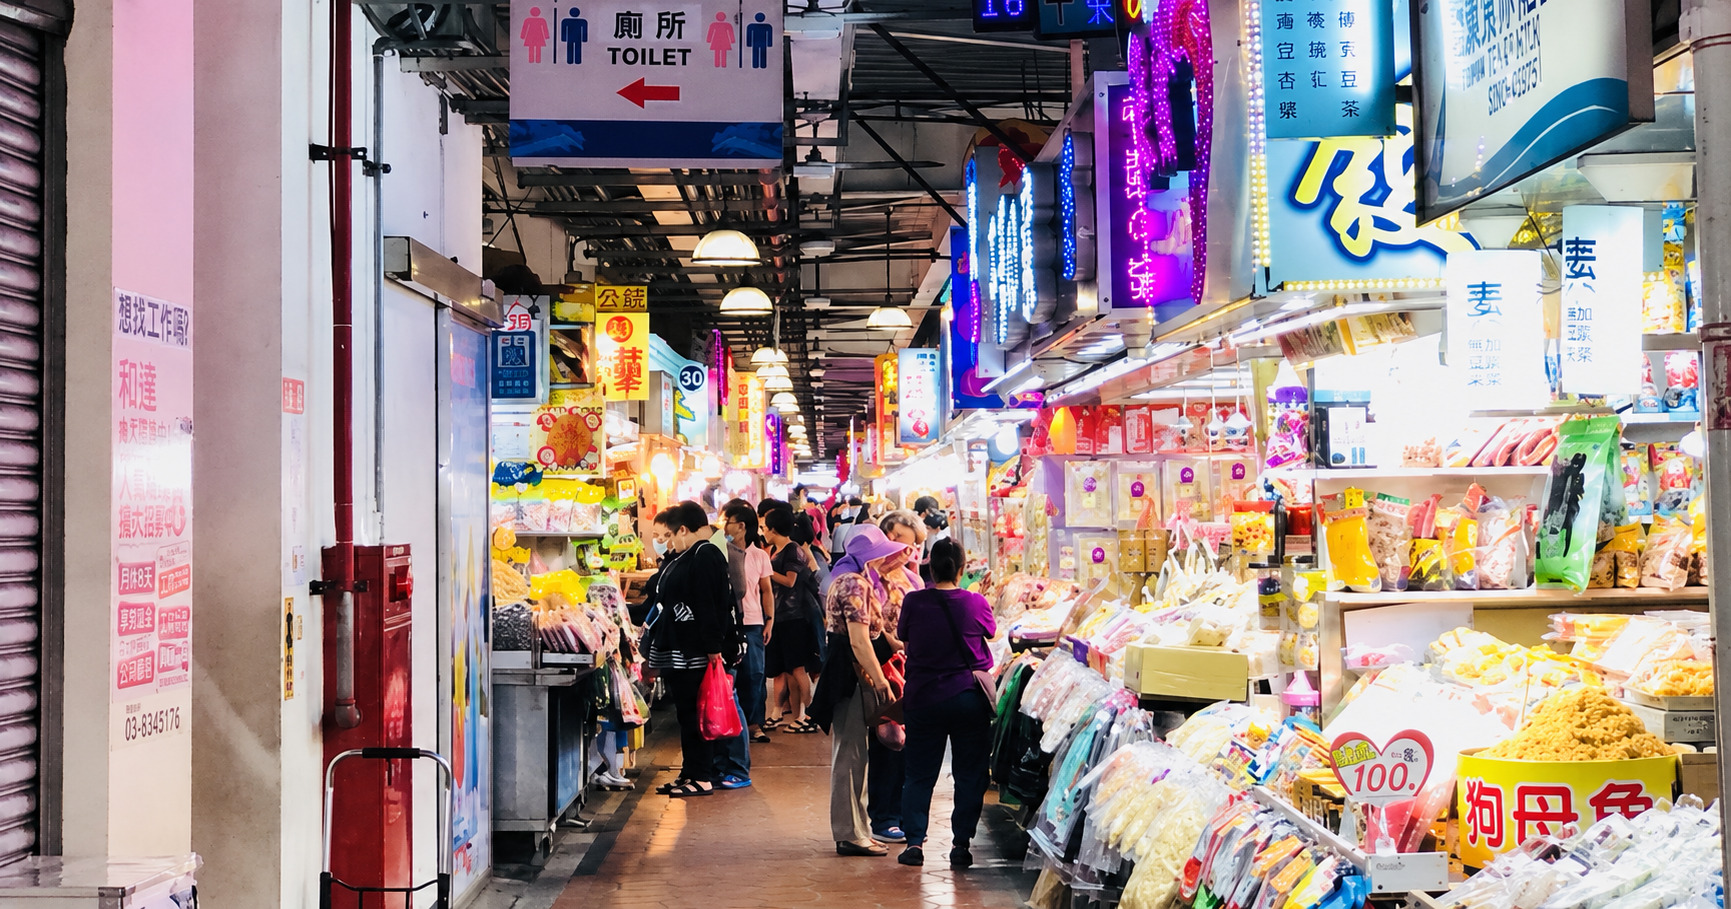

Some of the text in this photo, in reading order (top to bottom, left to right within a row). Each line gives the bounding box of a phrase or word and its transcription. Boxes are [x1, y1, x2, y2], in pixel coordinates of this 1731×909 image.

[607, 47, 692, 66] TOILET
[681, 371, 704, 386] 30
[125, 707, 180, 741] 03-8345176
